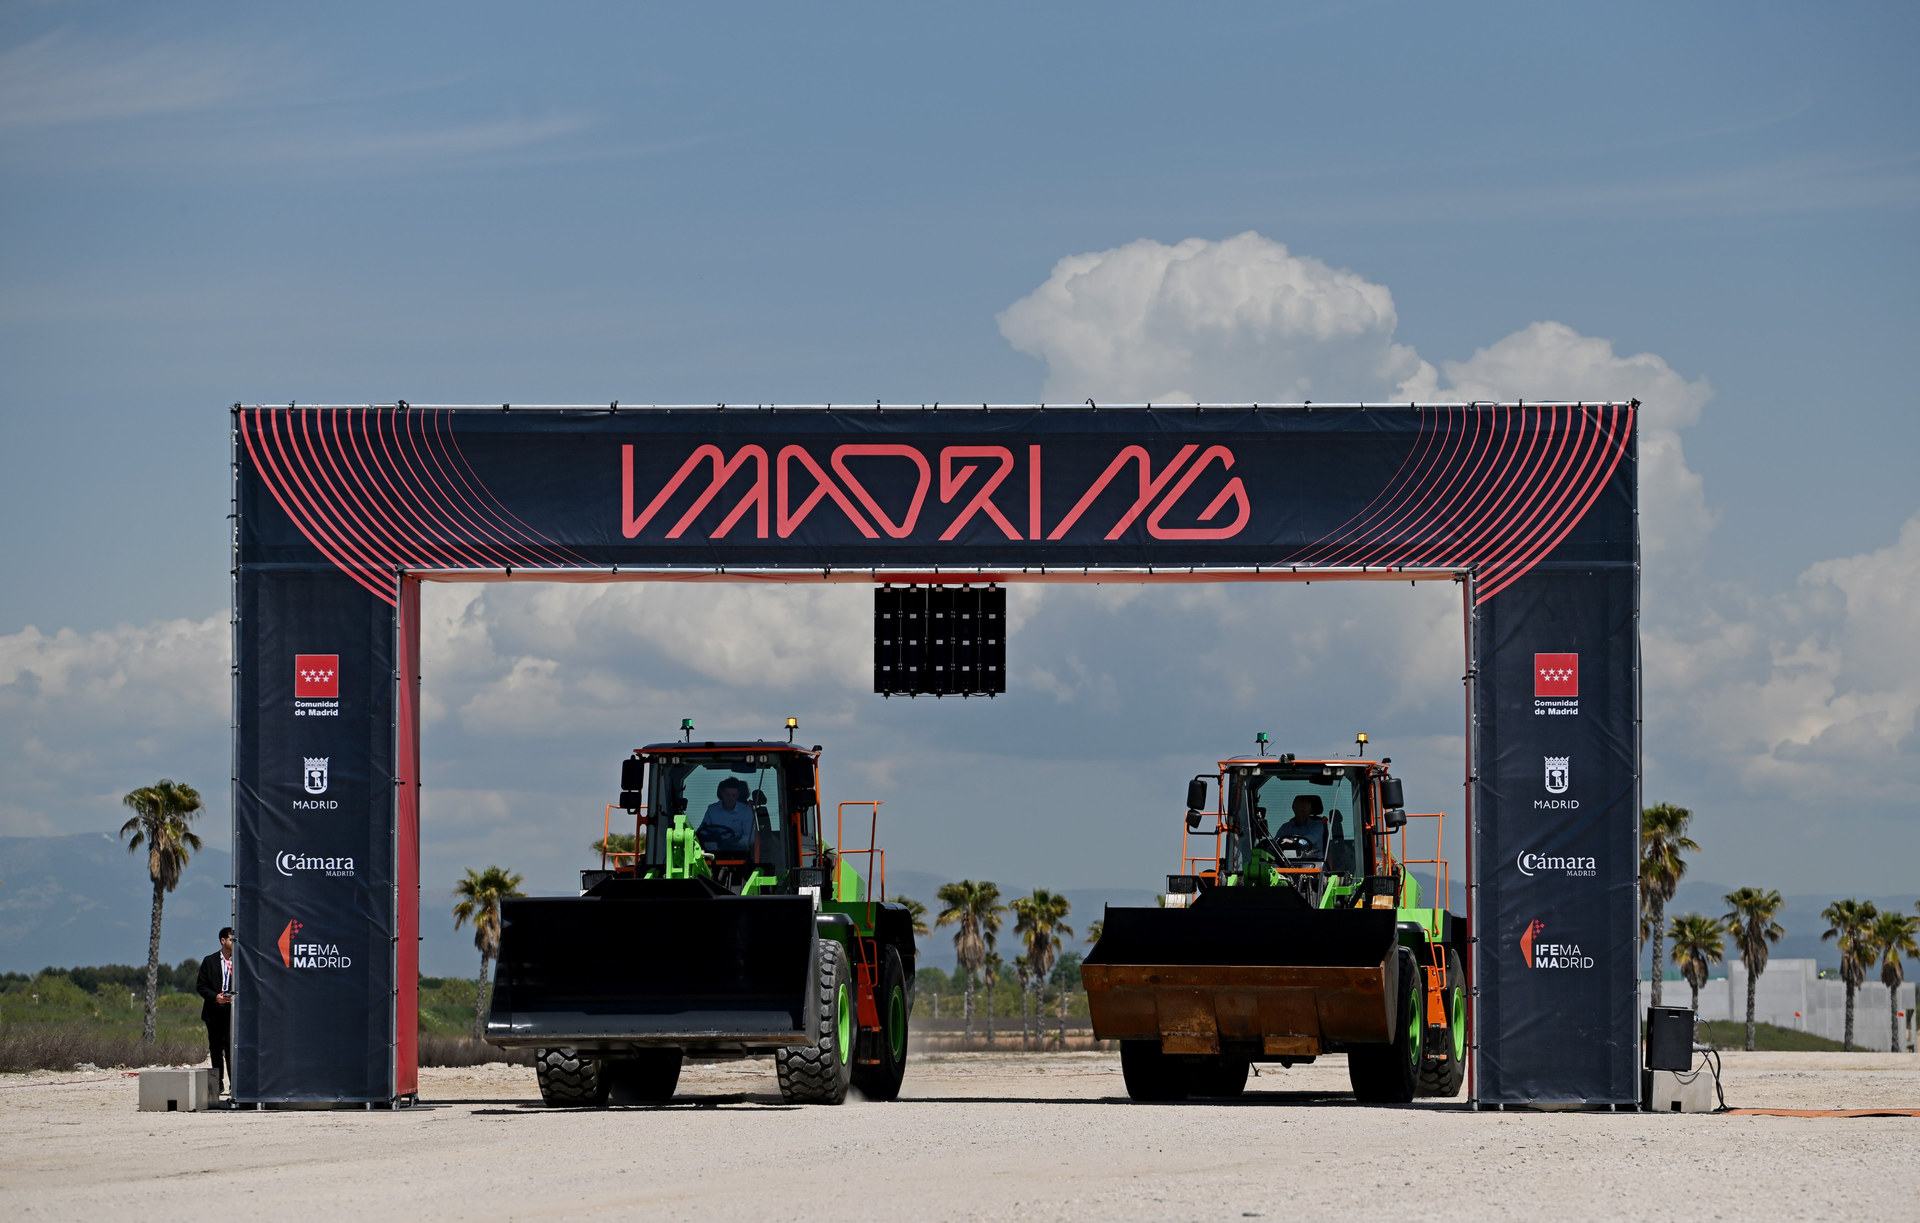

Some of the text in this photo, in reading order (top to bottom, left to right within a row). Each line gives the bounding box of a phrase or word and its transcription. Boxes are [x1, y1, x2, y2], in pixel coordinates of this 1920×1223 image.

[294, 700, 339, 708] Comunidad
[1534, 699, 1579, 707] Comunidad
[294, 709, 339, 717] de Madrid
[1534, 707, 1579, 716] de Madrid
[292, 800, 338, 810] MADRID
[1533, 799, 1580, 809] MADRID
[279, 851, 355, 871] Cámara
[1520, 851, 1597, 871] Cámara
[293, 944, 340, 956] IFEMA
[1535, 944, 1582, 956] IFEMA
[293, 956, 352, 969] MADRID
[1535, 956, 1595, 969] MADRID
